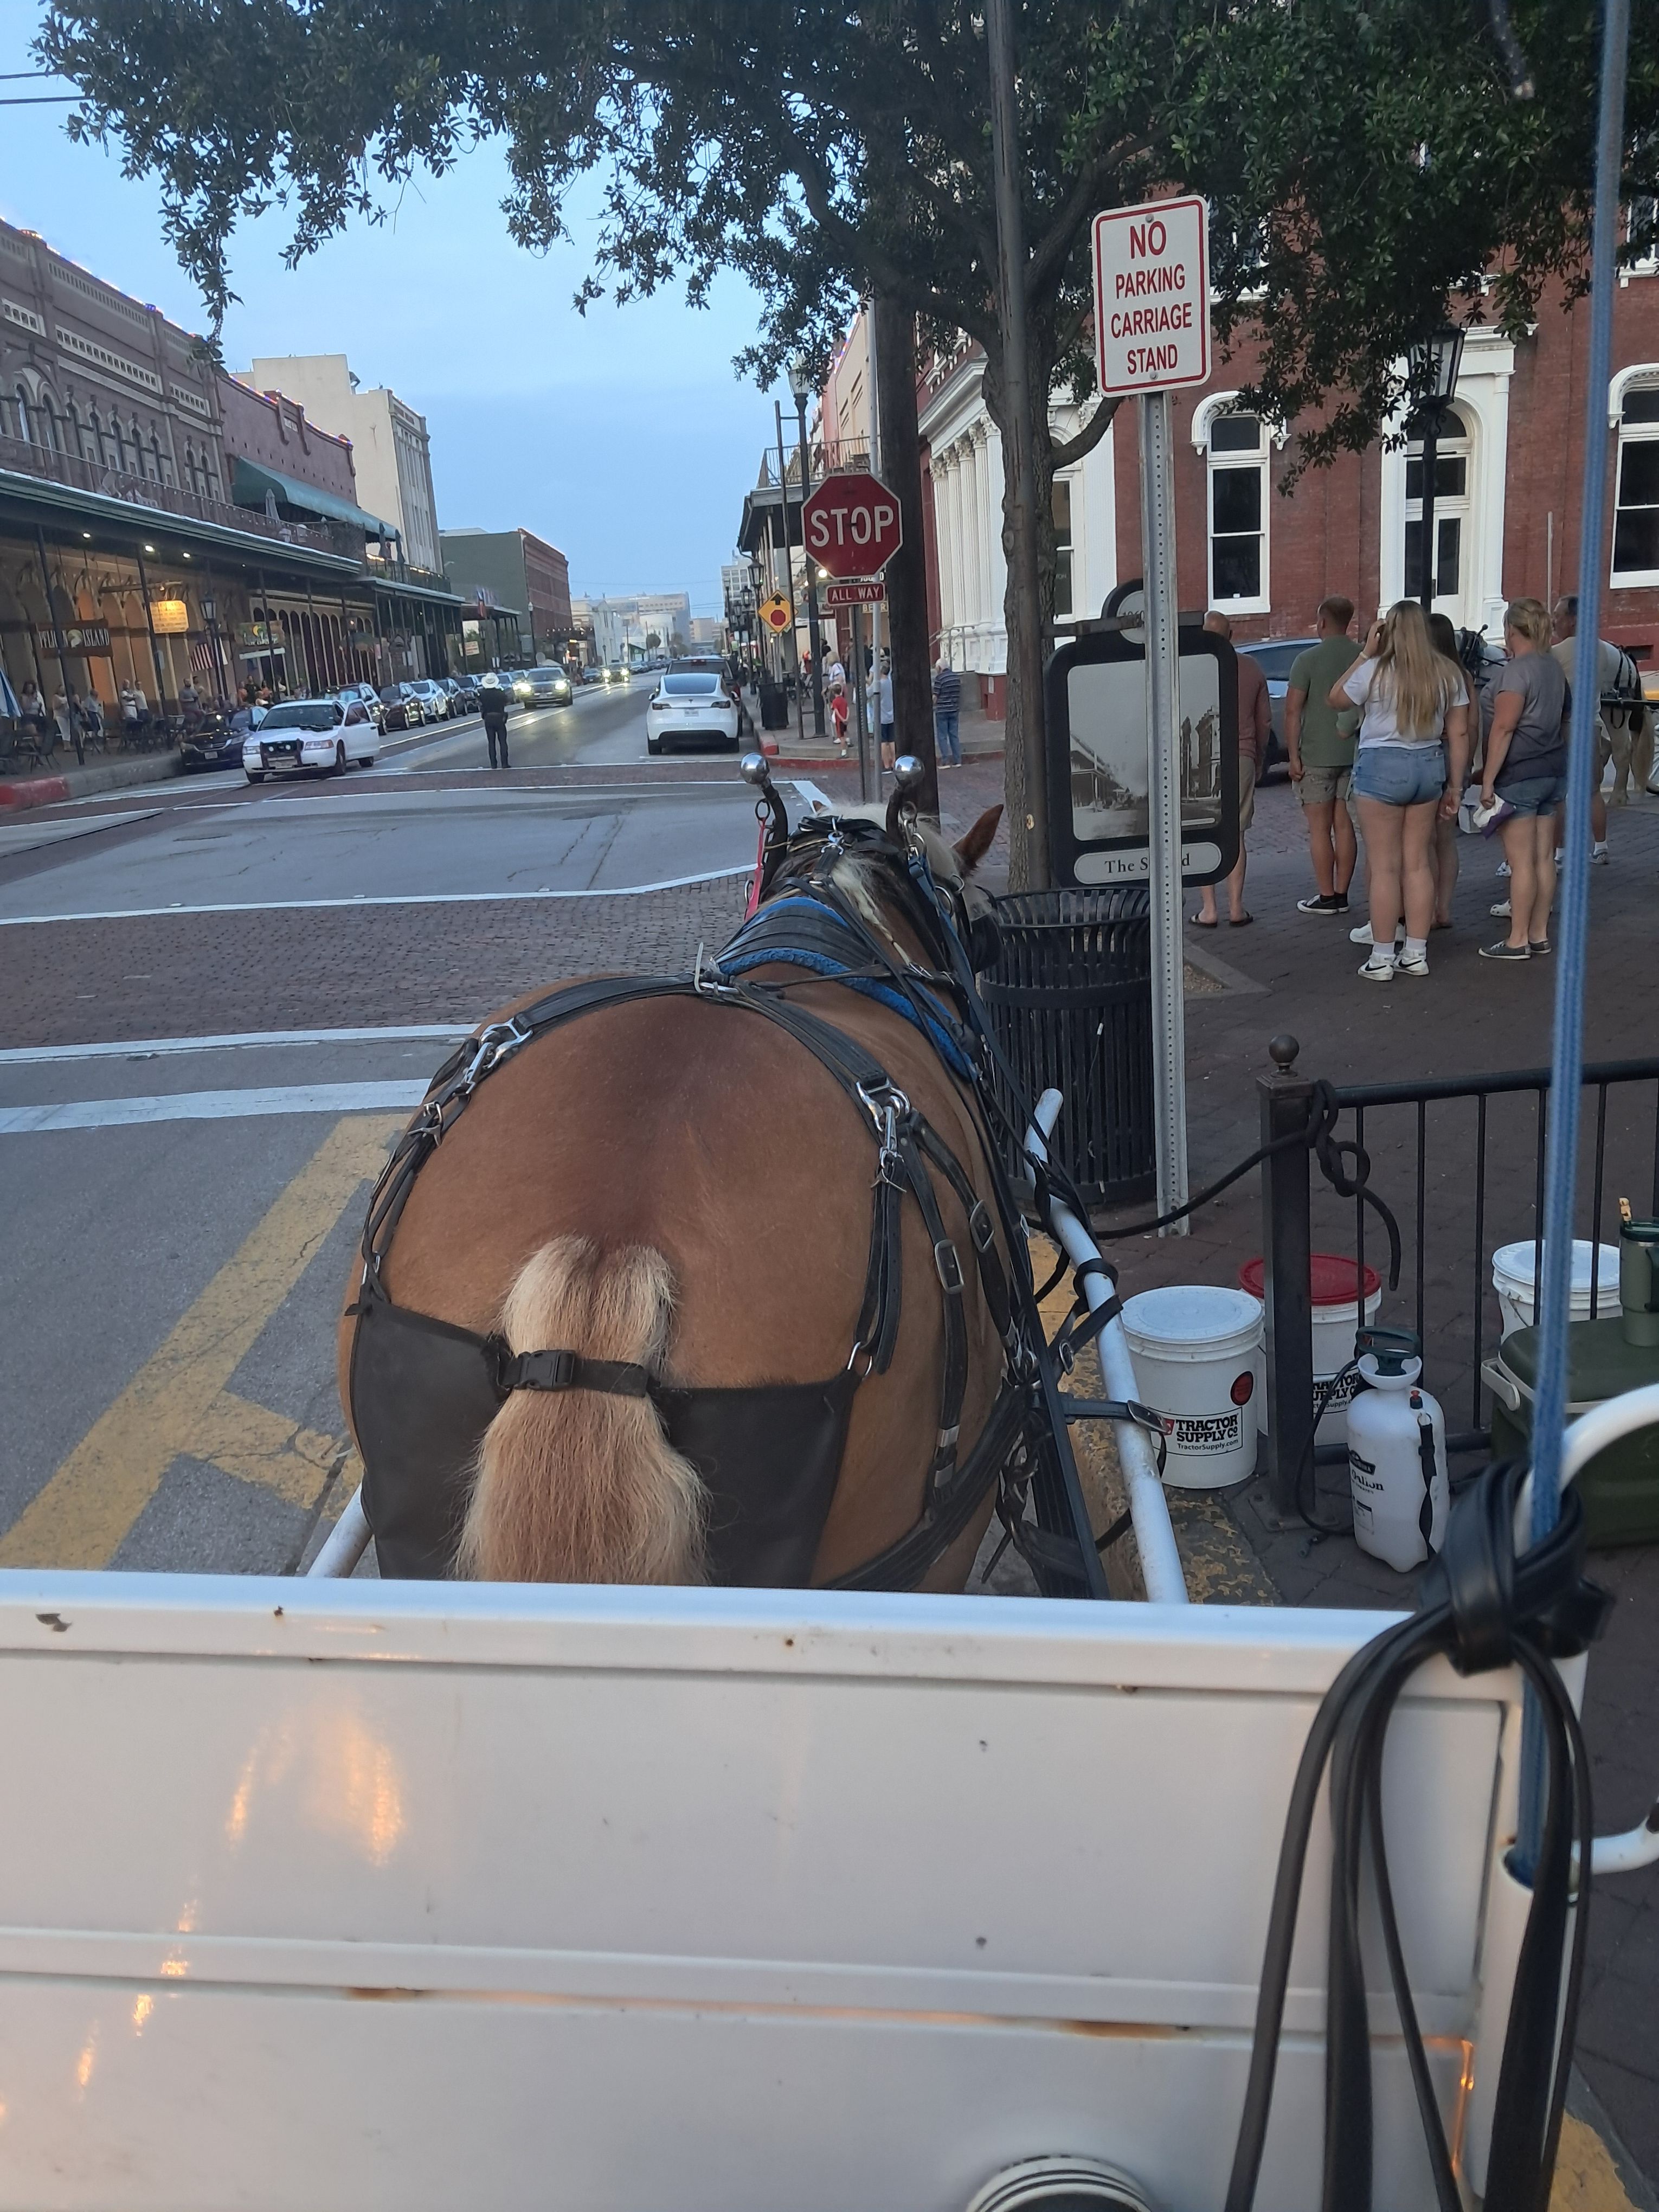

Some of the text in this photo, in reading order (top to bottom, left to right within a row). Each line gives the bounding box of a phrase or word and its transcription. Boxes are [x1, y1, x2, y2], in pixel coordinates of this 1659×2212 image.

[1130, 221, 1166, 259] NO
[1116, 263, 1185, 299] PARKING
[1111, 302, 1192, 339] CARRIAGE
[1127, 344, 1178, 375] STAND
[811, 505, 893, 547] STOP
[832, 587, 879, 602] ALL WAY
[863, 603, 886, 613] BER
[82, 628, 110, 647] ISLAND
[1104, 859, 1135, 873] The
[1176, 1414, 1238, 1431] TRACTOR
[1176, 1429, 1226, 1443] SUPPLY
[1177, 1439, 1239, 1451] TractorSupply.com
